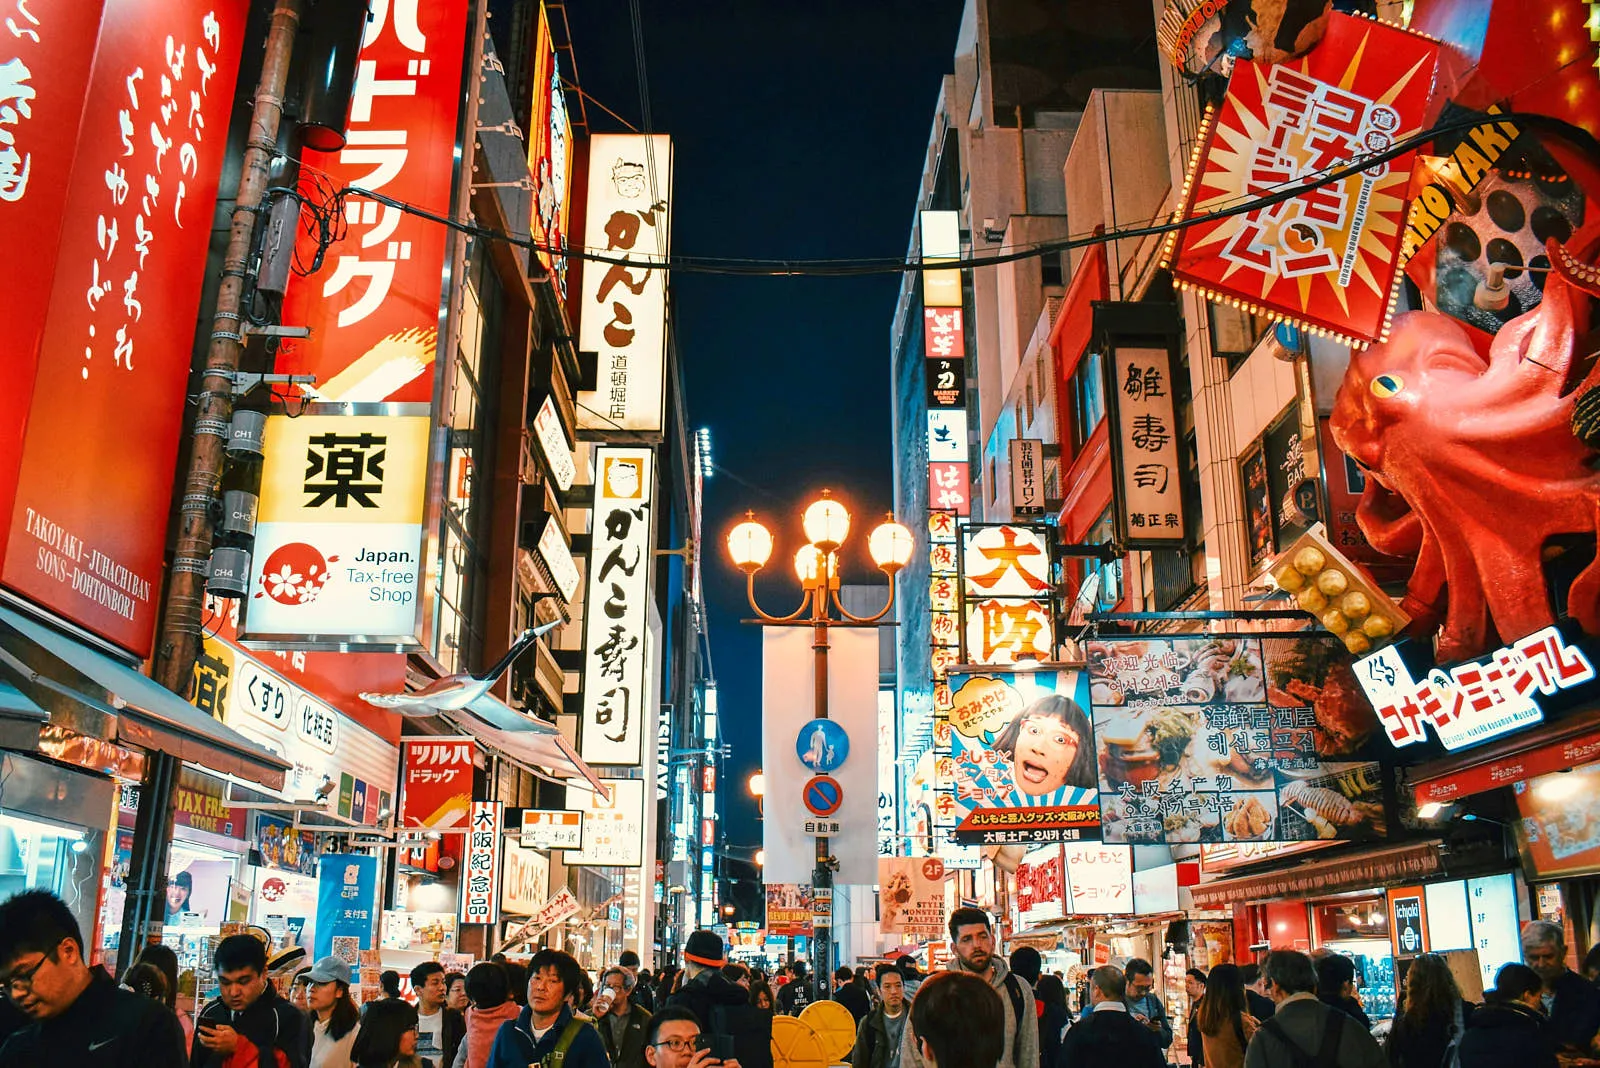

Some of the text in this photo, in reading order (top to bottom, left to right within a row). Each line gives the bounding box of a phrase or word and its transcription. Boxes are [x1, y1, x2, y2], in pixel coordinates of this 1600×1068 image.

[596, 200, 668, 347] がんこ
[609, 355, 627, 420] 道頓堀店
[304, 432, 387, 508] 薬
[232, 511, 251, 521] CH3
[1131, 513, 1179, 528] 菊正宗
[355, 547, 415, 564] Japan.
[214, 568, 233, 577] CH4
[346, 568, 414, 584] Tax-free
[369, 586, 412, 605] Shop
[1101, 652, 1179, 676] 欢迎光临
[1109, 674, 1183, 695] 어서오세요
[248, 674, 285, 719] くすり
[303, 705, 333, 745] 化粧品
[1207, 731, 1316, 755] 해선호프집
[411, 746, 471, 765] ツルハ
[956, 750, 1011, 763] よしもと
[410, 769, 459, 784] ドラッグ
[957, 784, 1014, 800] ショップ
[1118, 774, 1233, 799] 大阪名产物
[177, 790, 231, 819] TAX FREE
[1124, 795, 1234, 819] 오오사까특산품
[190, 814, 218, 832] STORE
[805, 822, 839, 833] 自動車
[469, 809, 495, 915] 大阪紀念品
[1071, 851, 1123, 864] よしもと
[925, 865, 941, 875] 2F
[1073, 883, 1126, 898] ショップ
[344, 910, 368, 919] 支付宝
